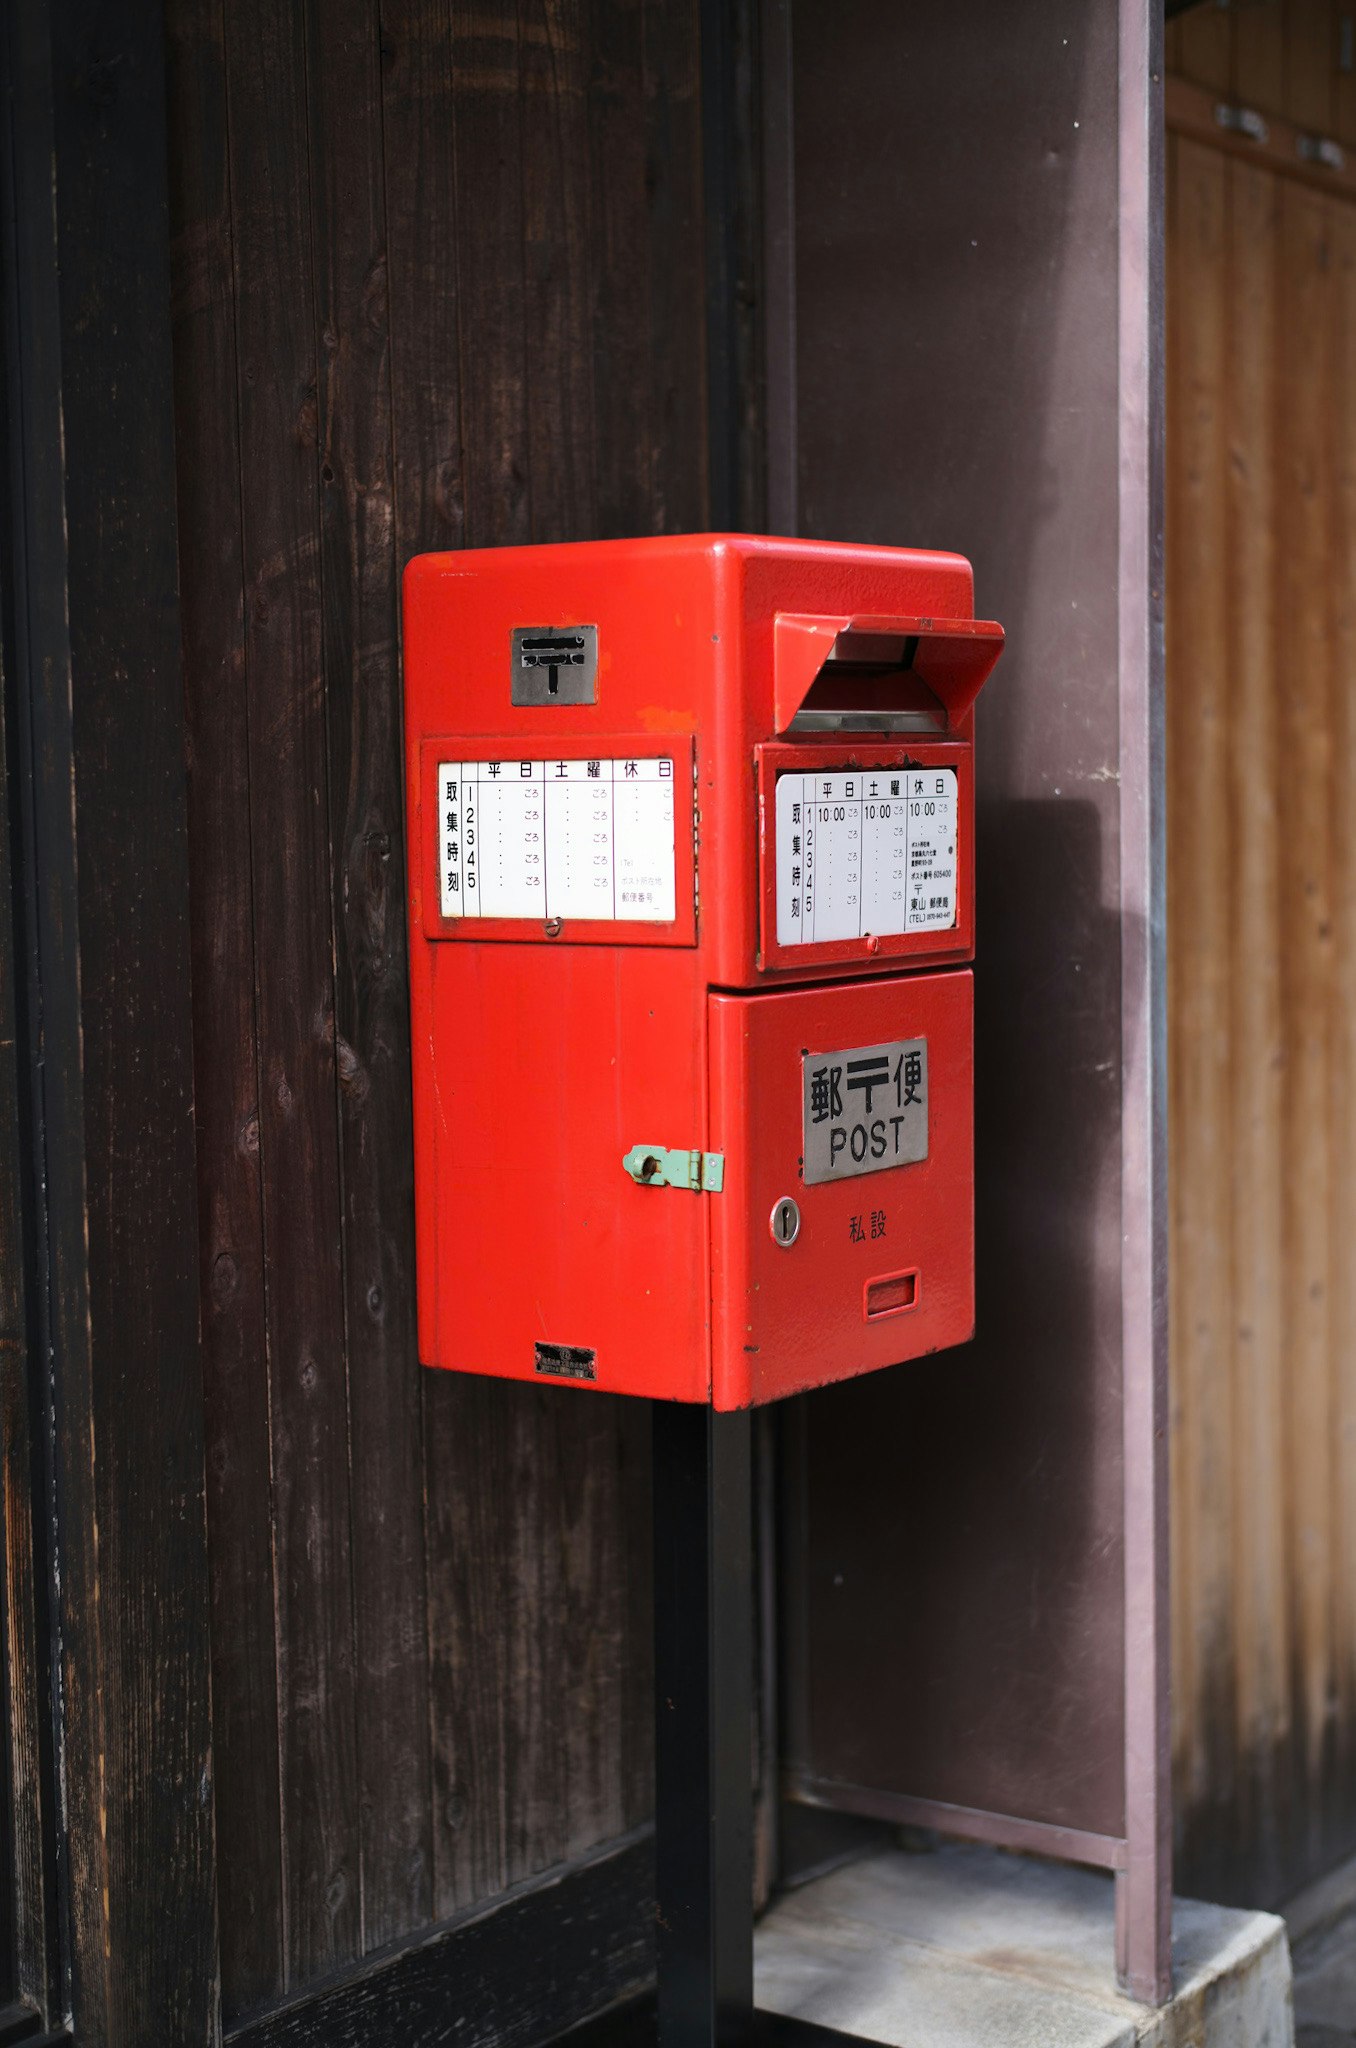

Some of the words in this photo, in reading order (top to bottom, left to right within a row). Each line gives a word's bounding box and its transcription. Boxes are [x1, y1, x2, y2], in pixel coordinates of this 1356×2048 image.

[466, 808, 474, 823] 2
[807, 809, 812, 823] 1
[818, 807, 845, 822] 10:00
[865, 805, 891, 819] 10:00
[910, 802, 935, 816] 10:00
[467, 830, 474, 845] 3
[807, 830, 812, 846] 2
[467, 851, 475, 866] 4
[807, 852, 812, 868] 3
[468, 873, 475, 888] 5
[807, 875, 812, 889] 4
[806, 897, 812, 912] 5
[831, 1116, 905, 1167] POST
[850, 1210, 887, 1243] 私設
